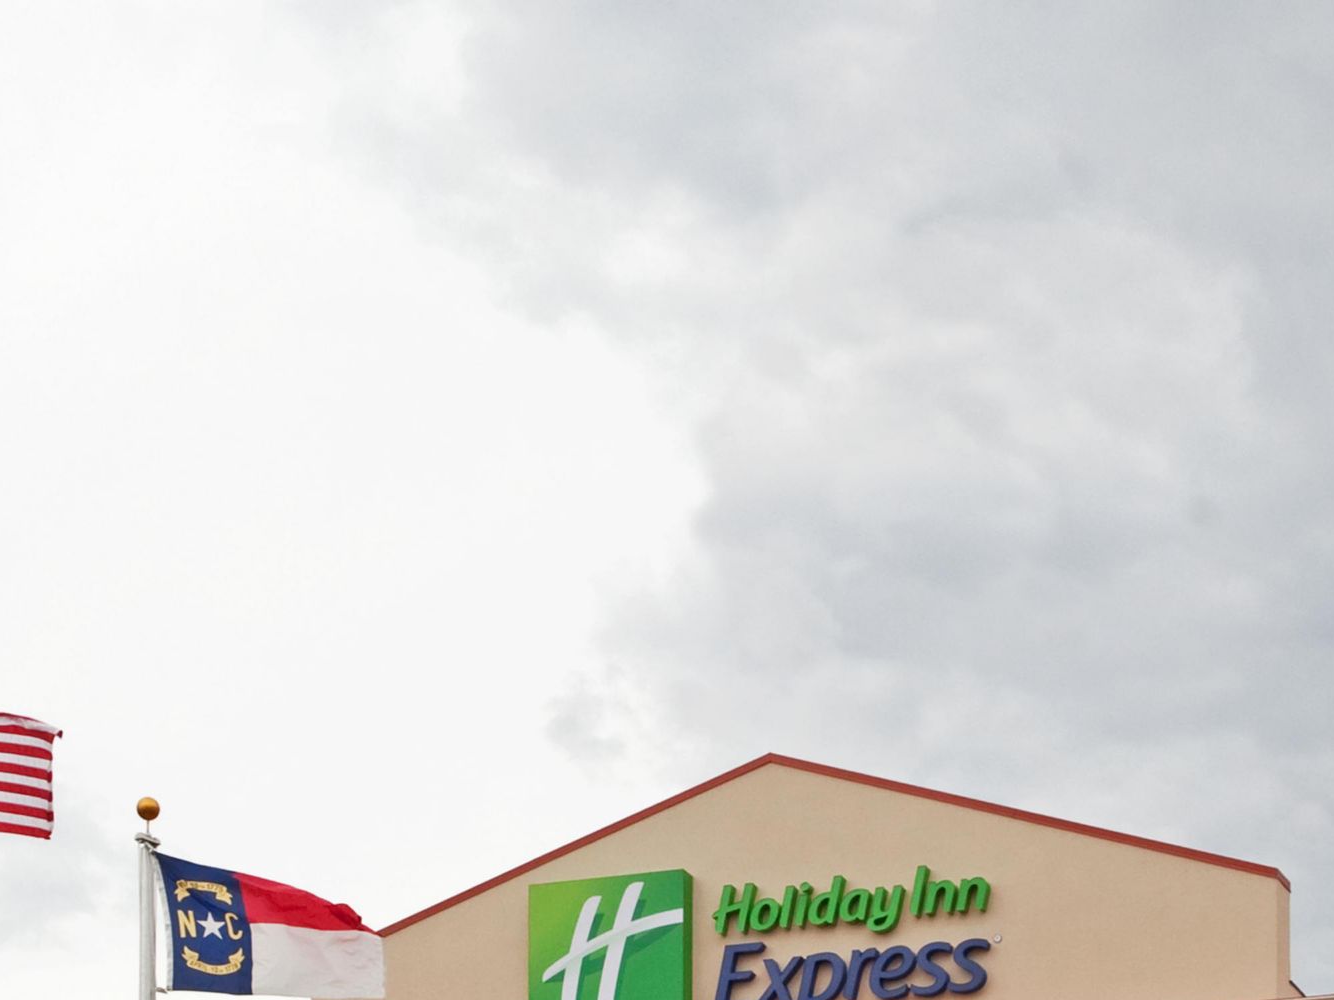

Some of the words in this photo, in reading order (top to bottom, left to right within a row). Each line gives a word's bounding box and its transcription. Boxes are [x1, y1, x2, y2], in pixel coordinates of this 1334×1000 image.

[177, 910, 197, 938] N
[224, 912, 244, 940] C
[712, 875, 906, 936] Holiday
[909, 865, 991, 918] Inn
